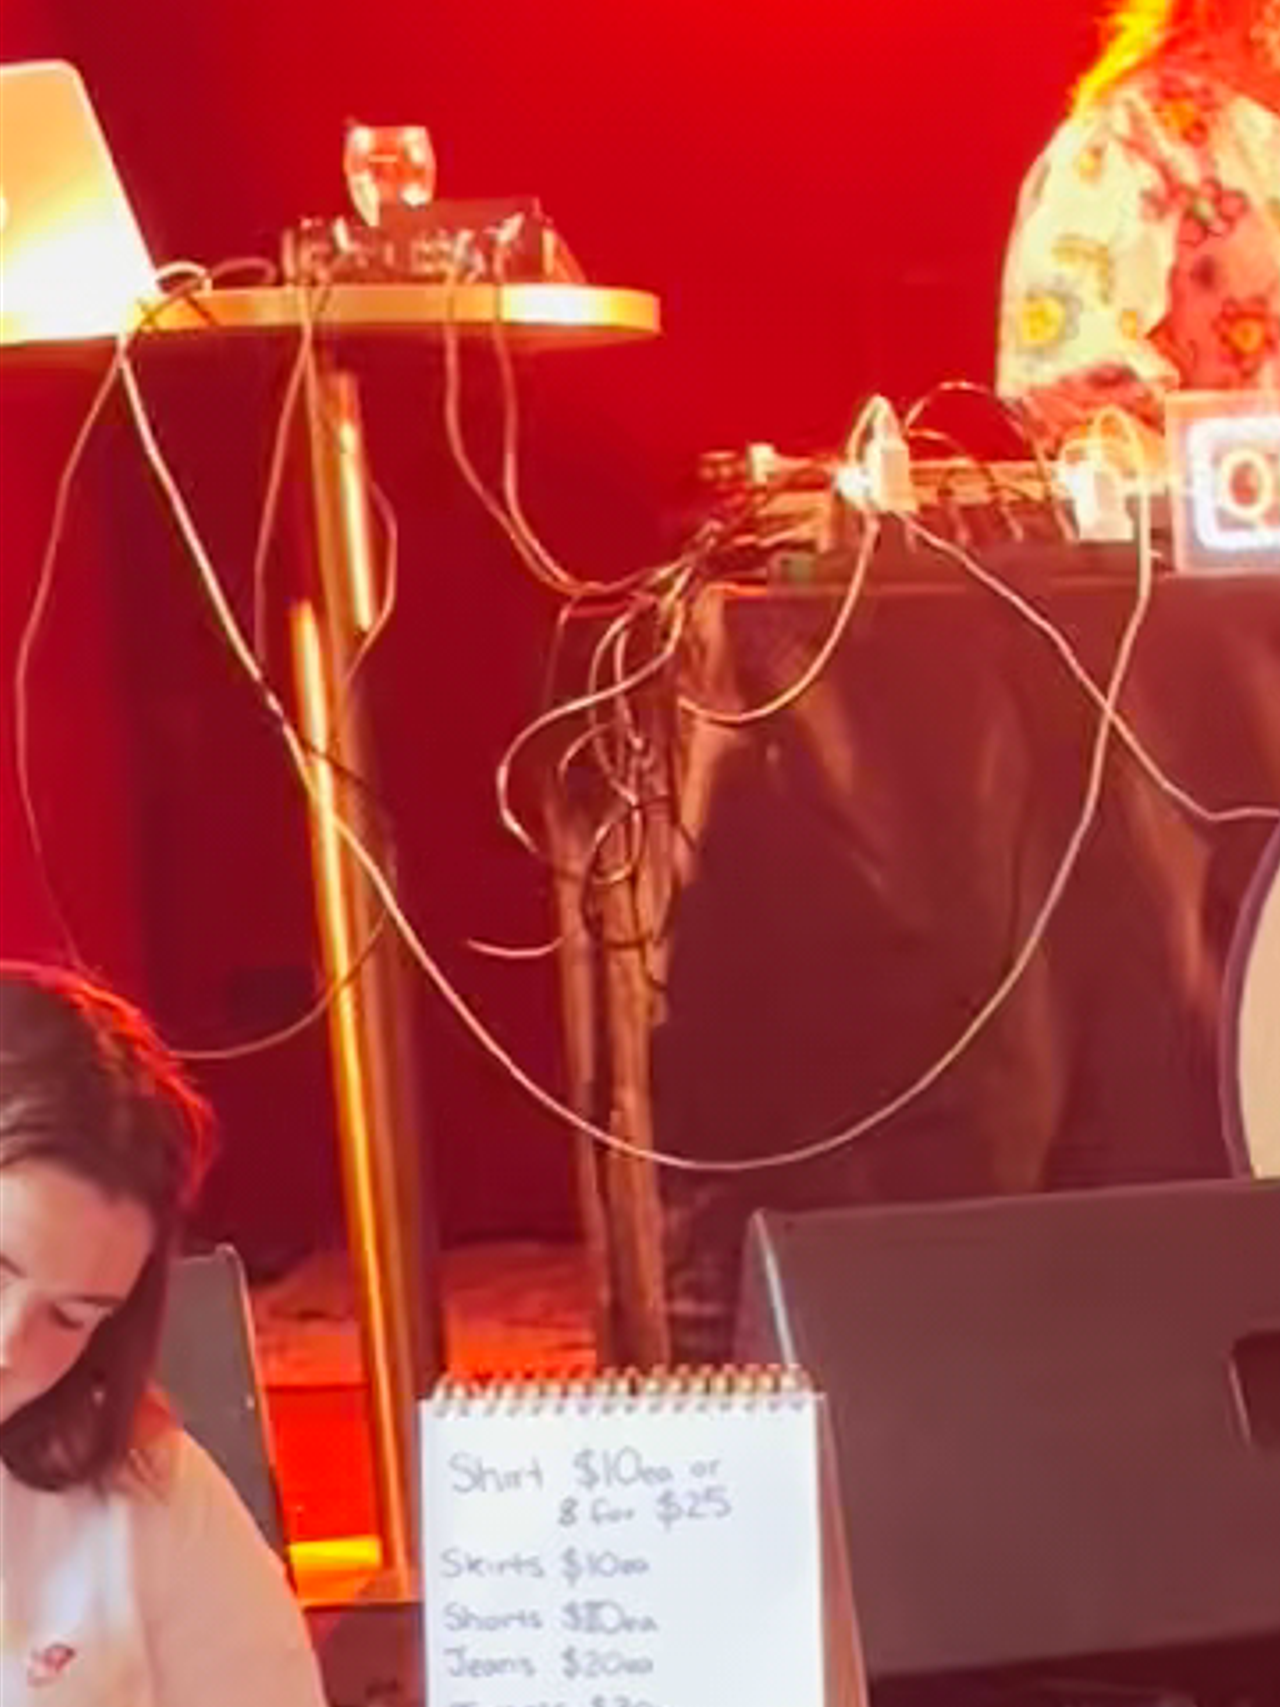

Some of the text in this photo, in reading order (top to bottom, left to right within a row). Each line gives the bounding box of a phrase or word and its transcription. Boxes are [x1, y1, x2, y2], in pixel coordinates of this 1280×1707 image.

[449, 1451, 543, 1493] Shirt
[689, 1459, 721, 1477] or
[590, 1498, 634, 1524] for
[656, 1486, 732, 1532] $25
[440, 1548, 545, 1578] Skirts
[444, 1602, 544, 1631] Shorts
[444, 1645, 536, 1678] Jeans
